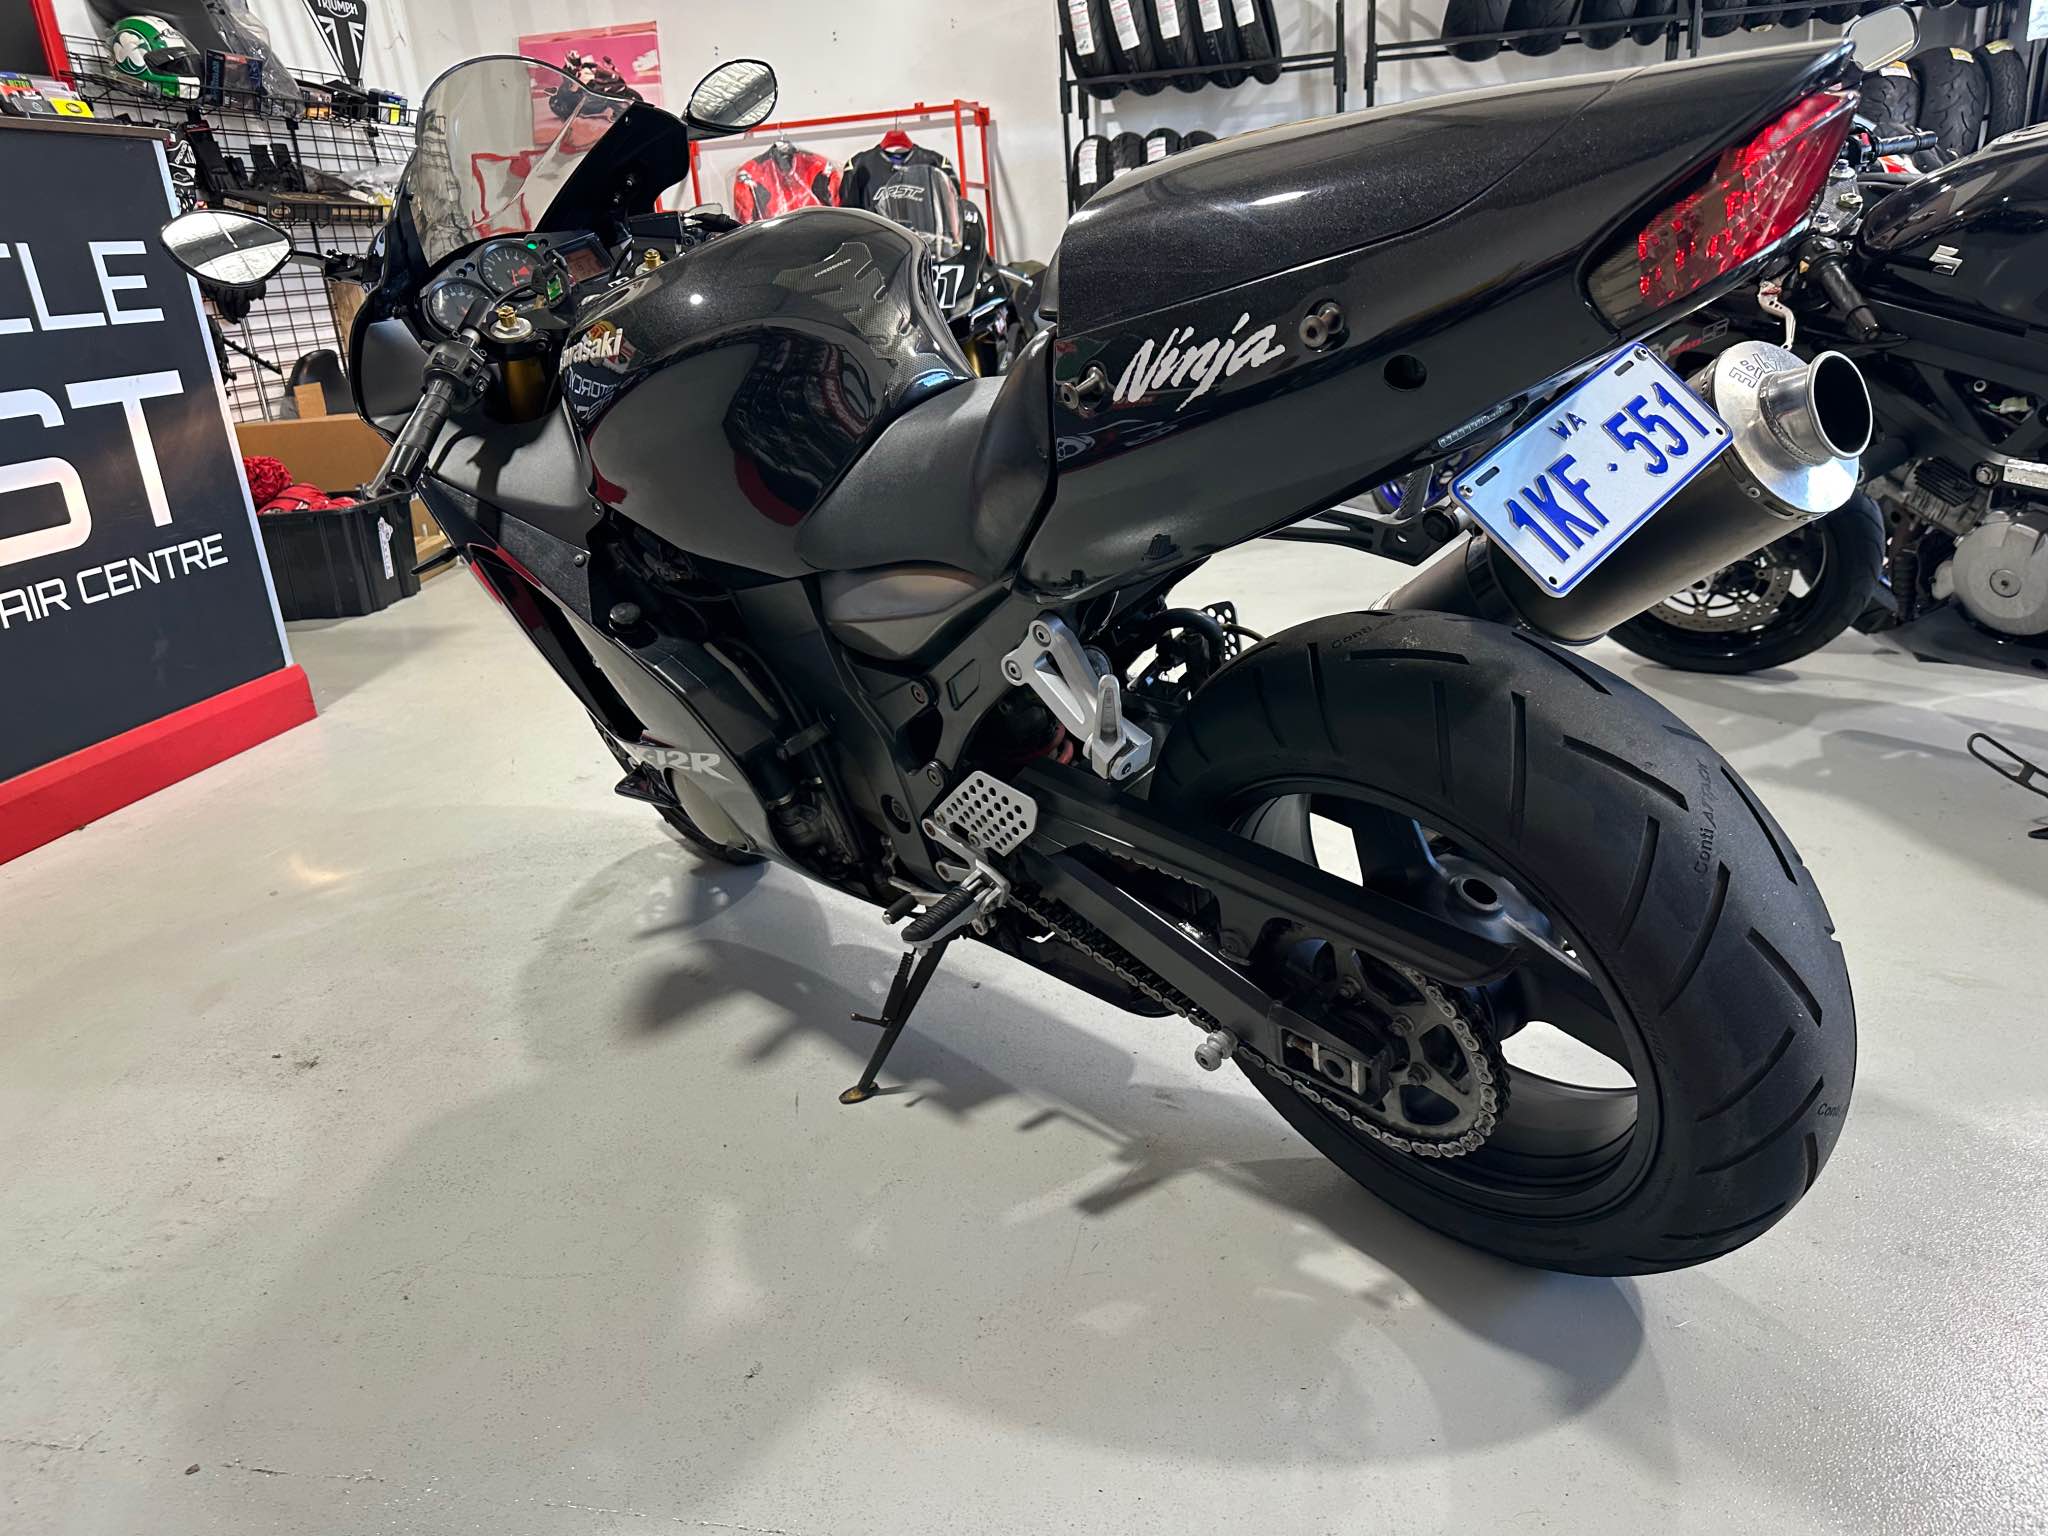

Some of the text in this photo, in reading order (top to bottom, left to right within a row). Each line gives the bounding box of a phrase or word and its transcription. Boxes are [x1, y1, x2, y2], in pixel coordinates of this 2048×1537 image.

[1112, 312, 1285, 412] Ninja
[1549, 411, 1587, 441] WA
[1504, 453, 1610, 563] 1KF
[1601, 381, 1711, 477] 551
[76, 532, 229, 605] CENTRE
[1693, 827, 1715, 875] Conti
